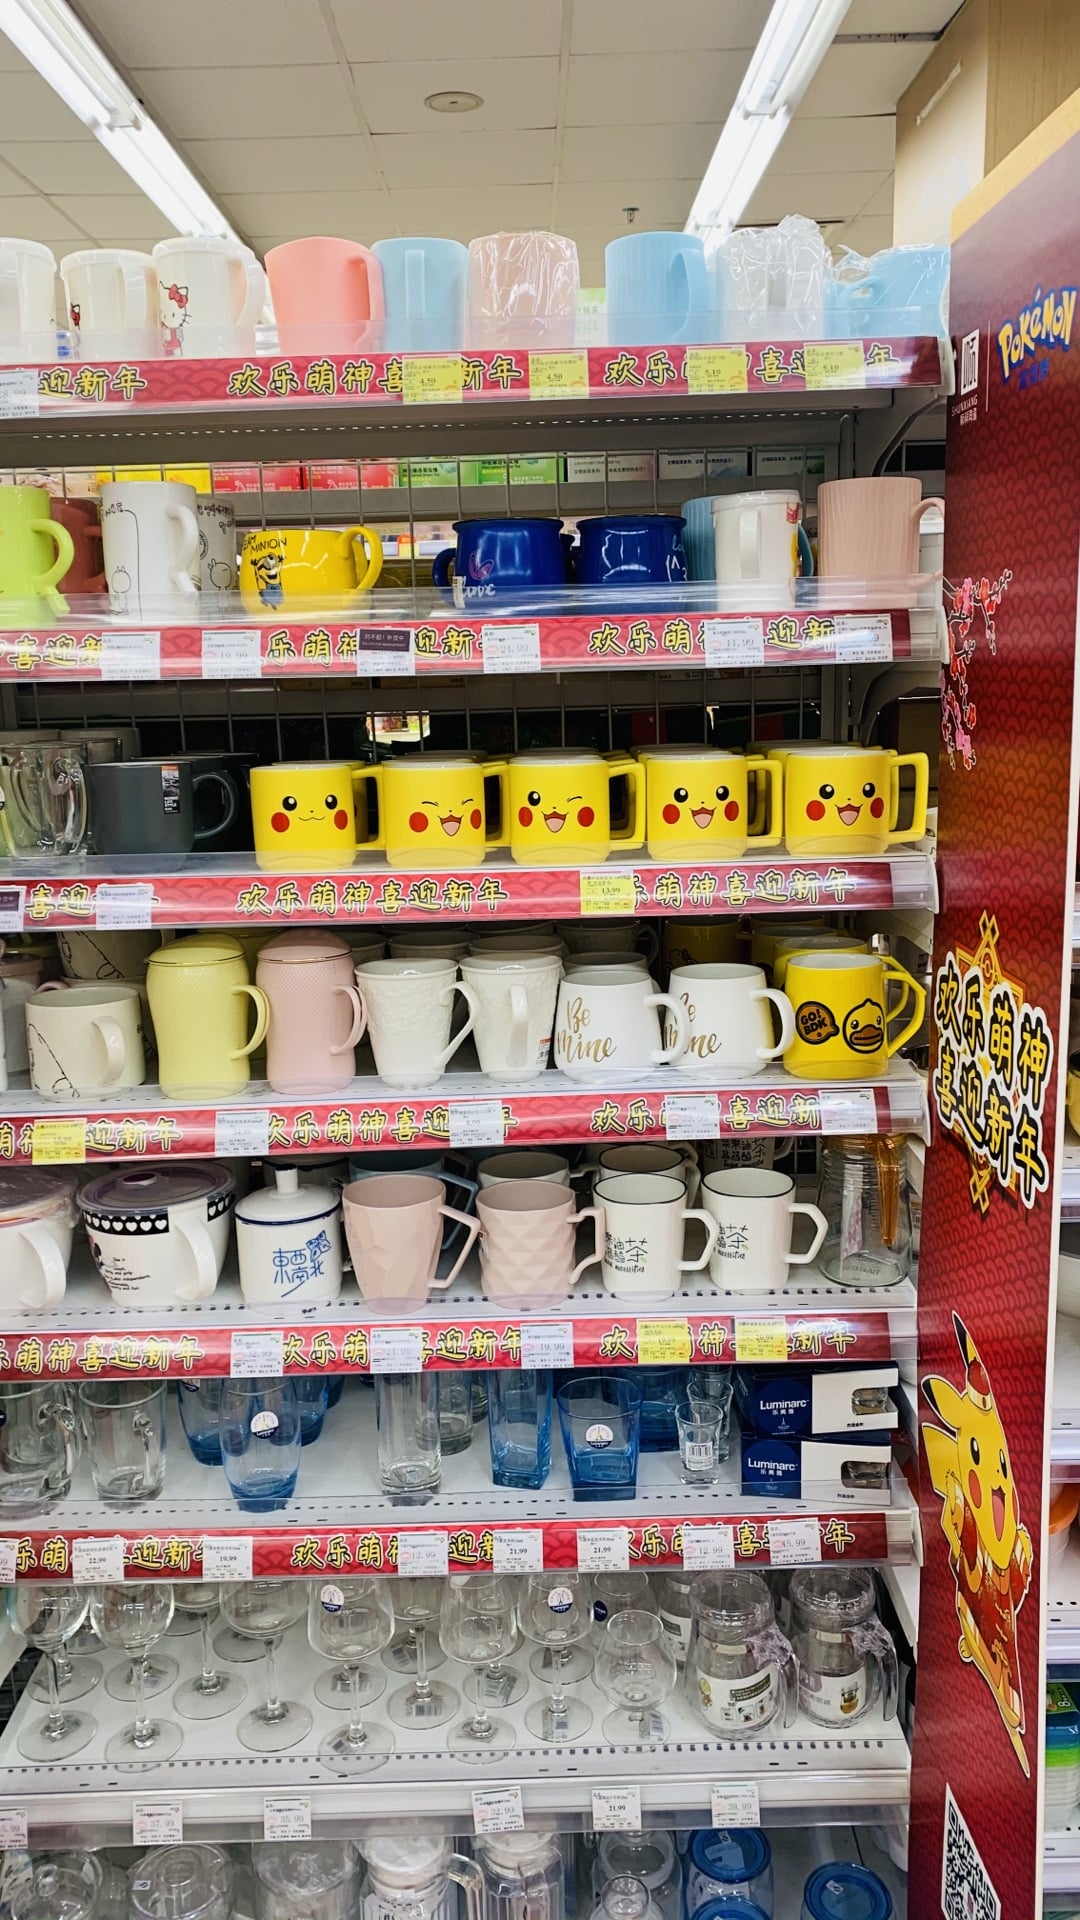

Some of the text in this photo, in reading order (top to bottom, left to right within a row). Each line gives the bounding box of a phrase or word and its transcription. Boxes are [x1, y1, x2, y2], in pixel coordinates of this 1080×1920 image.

[39, 366, 147, 402] 迎新年
[229, 356, 521, 396] 欢乐萌神喜新年
[251, 537, 287, 554] MINION
[589, 617, 836, 656] 欢乐萌迎新
[236, 879, 509, 917] 欢乐萌神喜迎新年
[566, 997, 591, 1033] Be
[801, 1009, 822, 1026] GO!
[804, 1017, 828, 1036] BDK
[937, 960, 1047, 1113] 欢乐萌神
[270, 1107, 518, 1147] 欢乐萌神喜迎
[592, 1094, 818, 1134] 欢乐喜迎新
[936, 1037, 1045, 1203] 喜迎新年
[626, 1237, 649, 1263] 茶
[283, 1327, 521, 1368] 欢乐萌迎新年
[760, 1400, 807, 1410] Luminarc
[748, 1458, 796, 1471] Luminarc
[17, 1538, 191, 1572] 乐萌迎新
